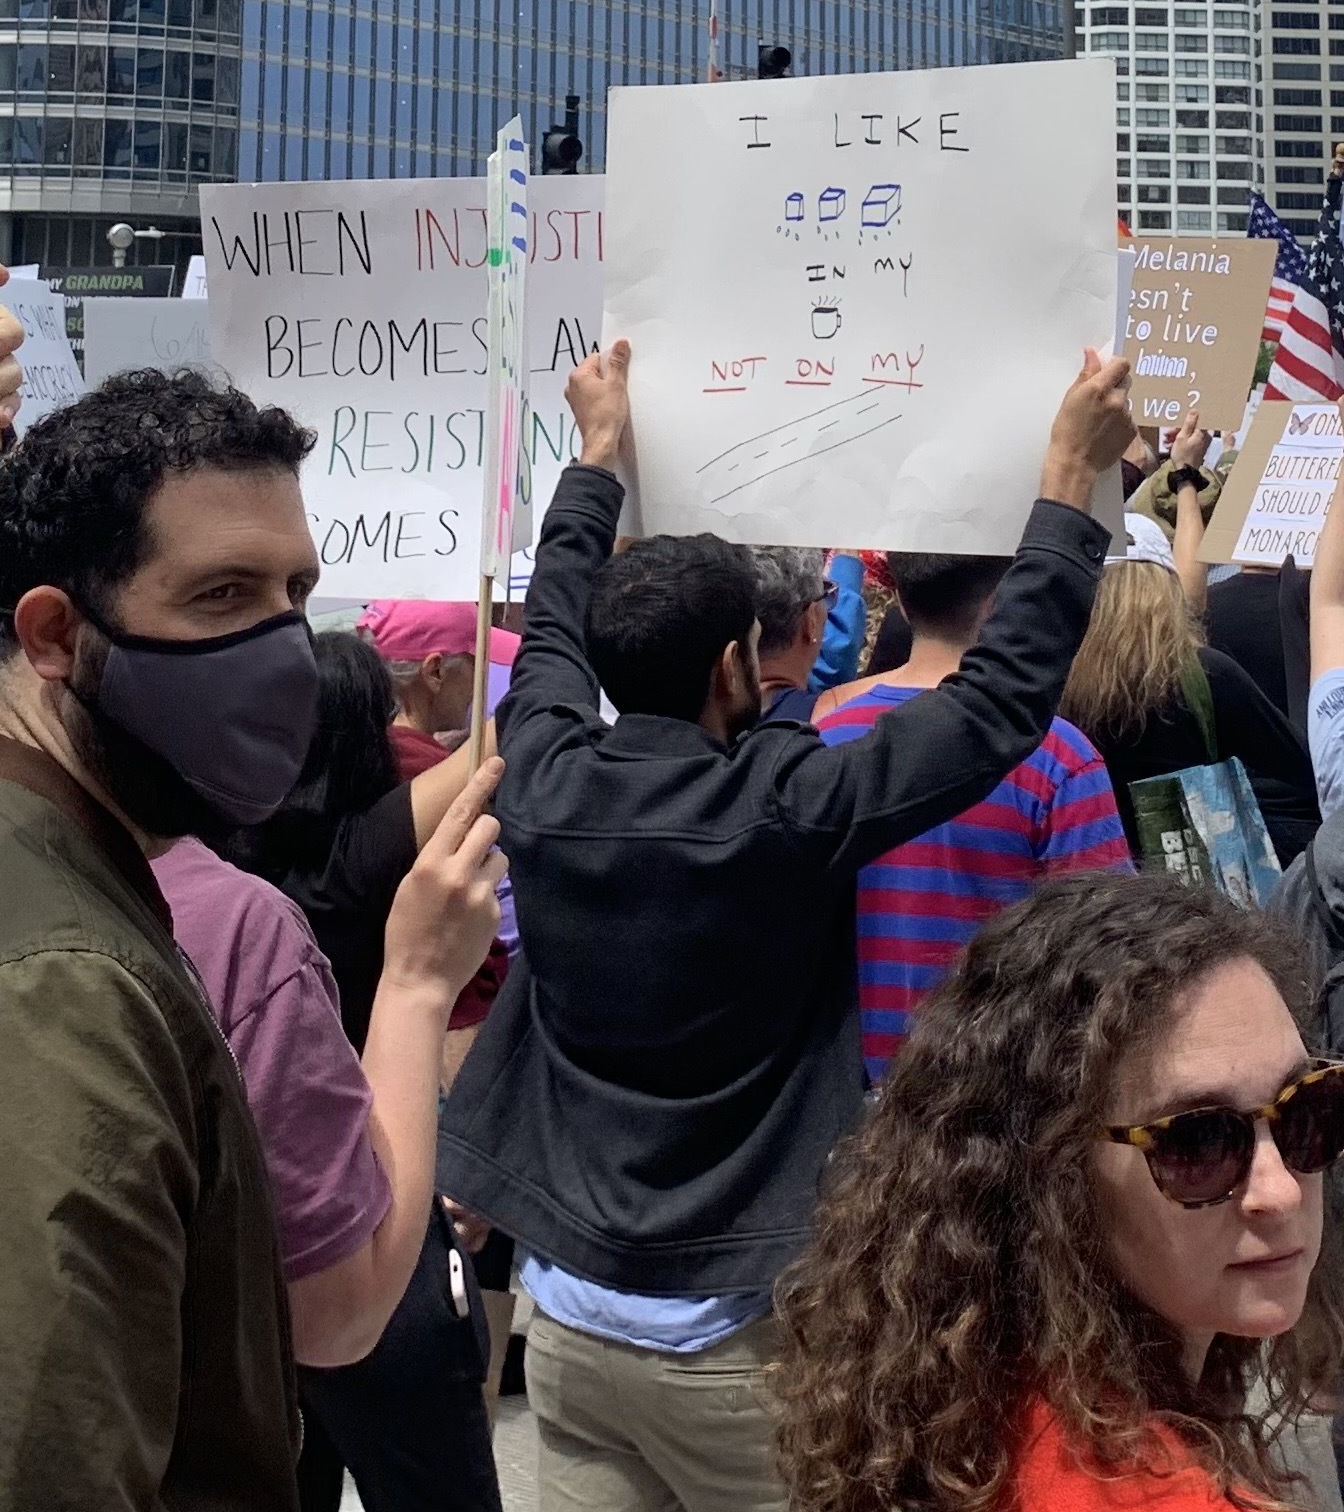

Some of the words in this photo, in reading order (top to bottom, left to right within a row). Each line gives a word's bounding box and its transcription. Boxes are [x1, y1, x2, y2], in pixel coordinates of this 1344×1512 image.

[739, 116, 772, 149] I
[834, 111, 969, 152] LIKE
[211, 209, 372, 277] WHEN
[415, 207, 604, 272] INJSTI
[65, 275, 144, 291] GRANDPA
[806, 264, 846, 283] IN
[1162, 314, 1218, 346] live
[264, 315, 489, 380] BECOMES
[711, 356, 768, 381] NOT
[796, 357, 836, 379] ON
[1256, 489, 1321, 516] SHOULD
